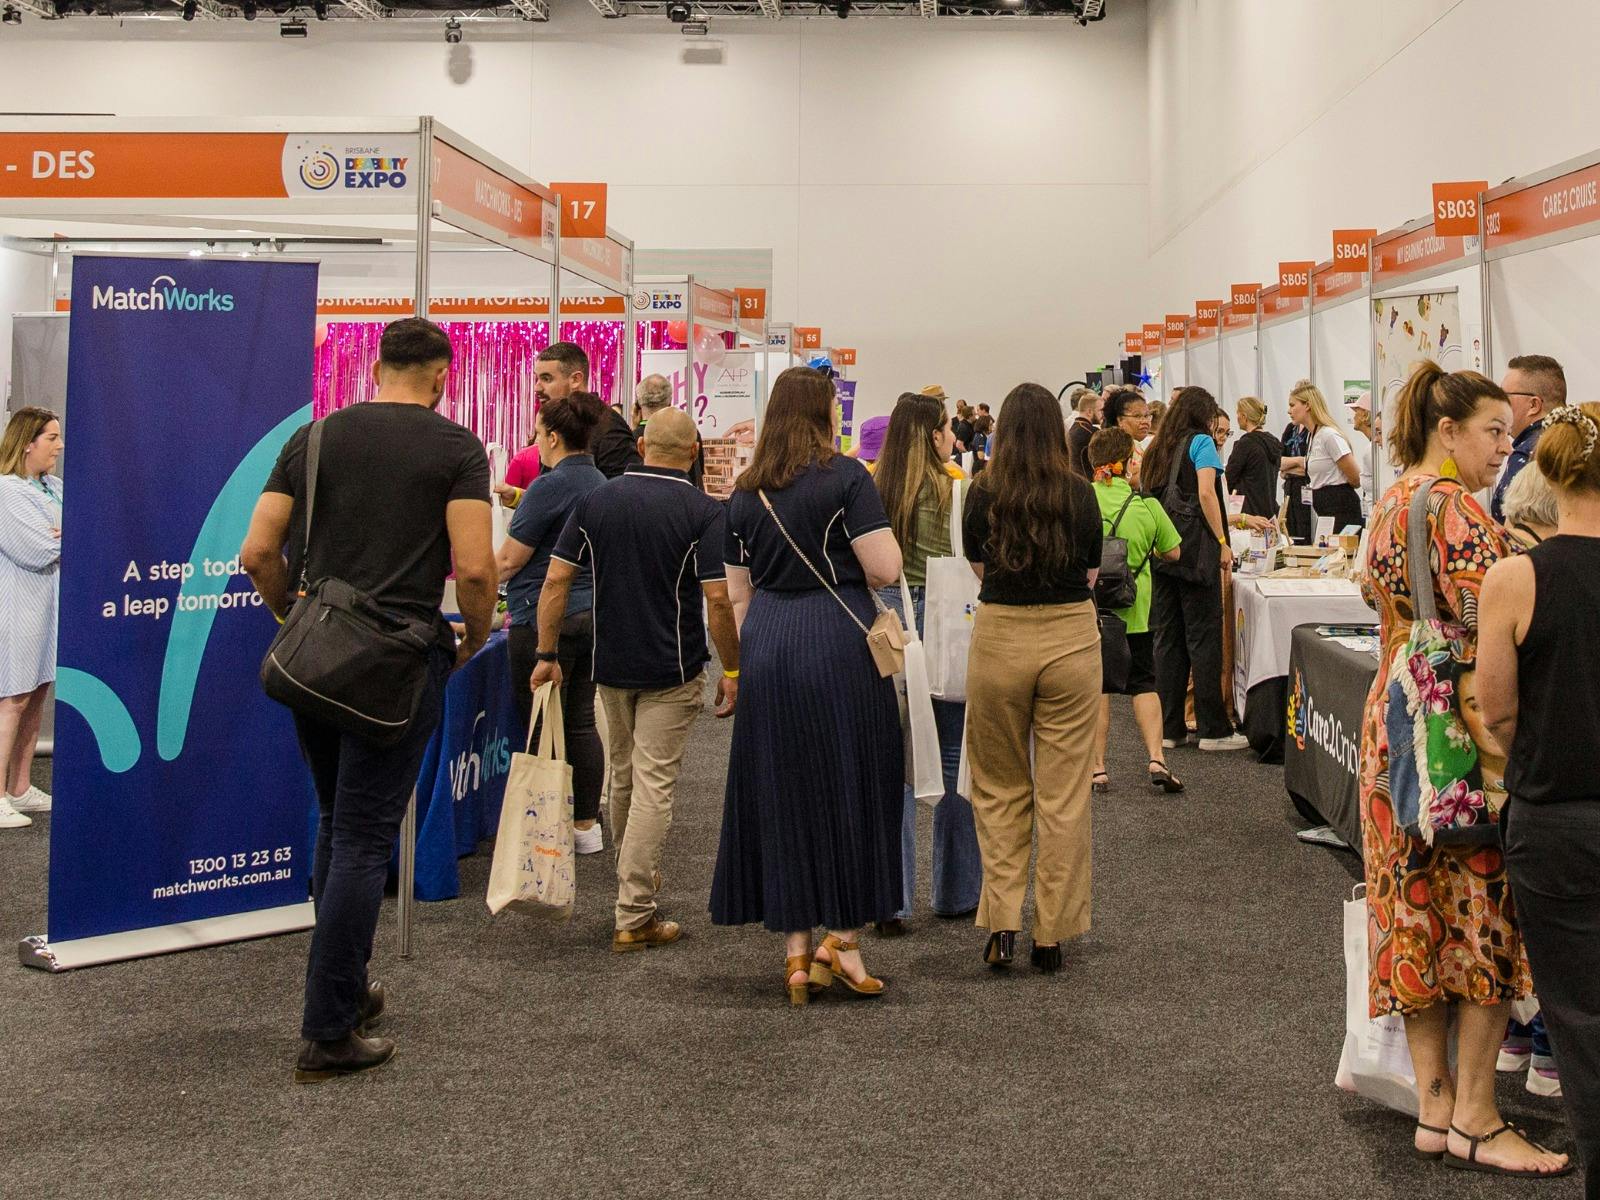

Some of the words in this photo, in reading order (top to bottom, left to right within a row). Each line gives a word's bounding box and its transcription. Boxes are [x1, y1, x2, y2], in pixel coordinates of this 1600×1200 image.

[32, 150, 95, 179] DES
[345, 172, 406, 188] EXPO
[571, 200, 596, 219] 17
[1438, 200, 1476, 219] SB03
[1486, 212, 1500, 236] SB03
[1543, 192, 1562, 219] CARE
[1563, 190, 1569, 213] 2
[1569, 181, 1597, 210] CRUISE
[1336, 243, 1367, 259] SB04
[1281, 273, 1307, 286] SB05
[92, 285, 235, 312] MatchWorks
[653, 301, 681, 309] EXPO
[744, 298, 758, 309] 31
[1234, 293, 1255, 305] SB06
[1198, 309, 1218, 319] SB07
[1144, 330, 1160, 339] SB09
[1167, 322, 1184, 331] SB08
[806, 334, 816, 342] 55
[667, 361, 708, 405] HY
[122, 560, 142, 583] A
[149, 560, 194, 584] step
[203, 554, 248, 577] toda
[102, 601, 116, 618] a
[124, 594, 169, 620] leap
[176, 591, 264, 612] tomorro
[189, 856, 227, 875] 1300
[231, 852, 246, 869] 13
[251, 849, 269, 866] 23
[274, 846, 292, 862] 63
[153, 867, 292, 899] matchworks.com.au
